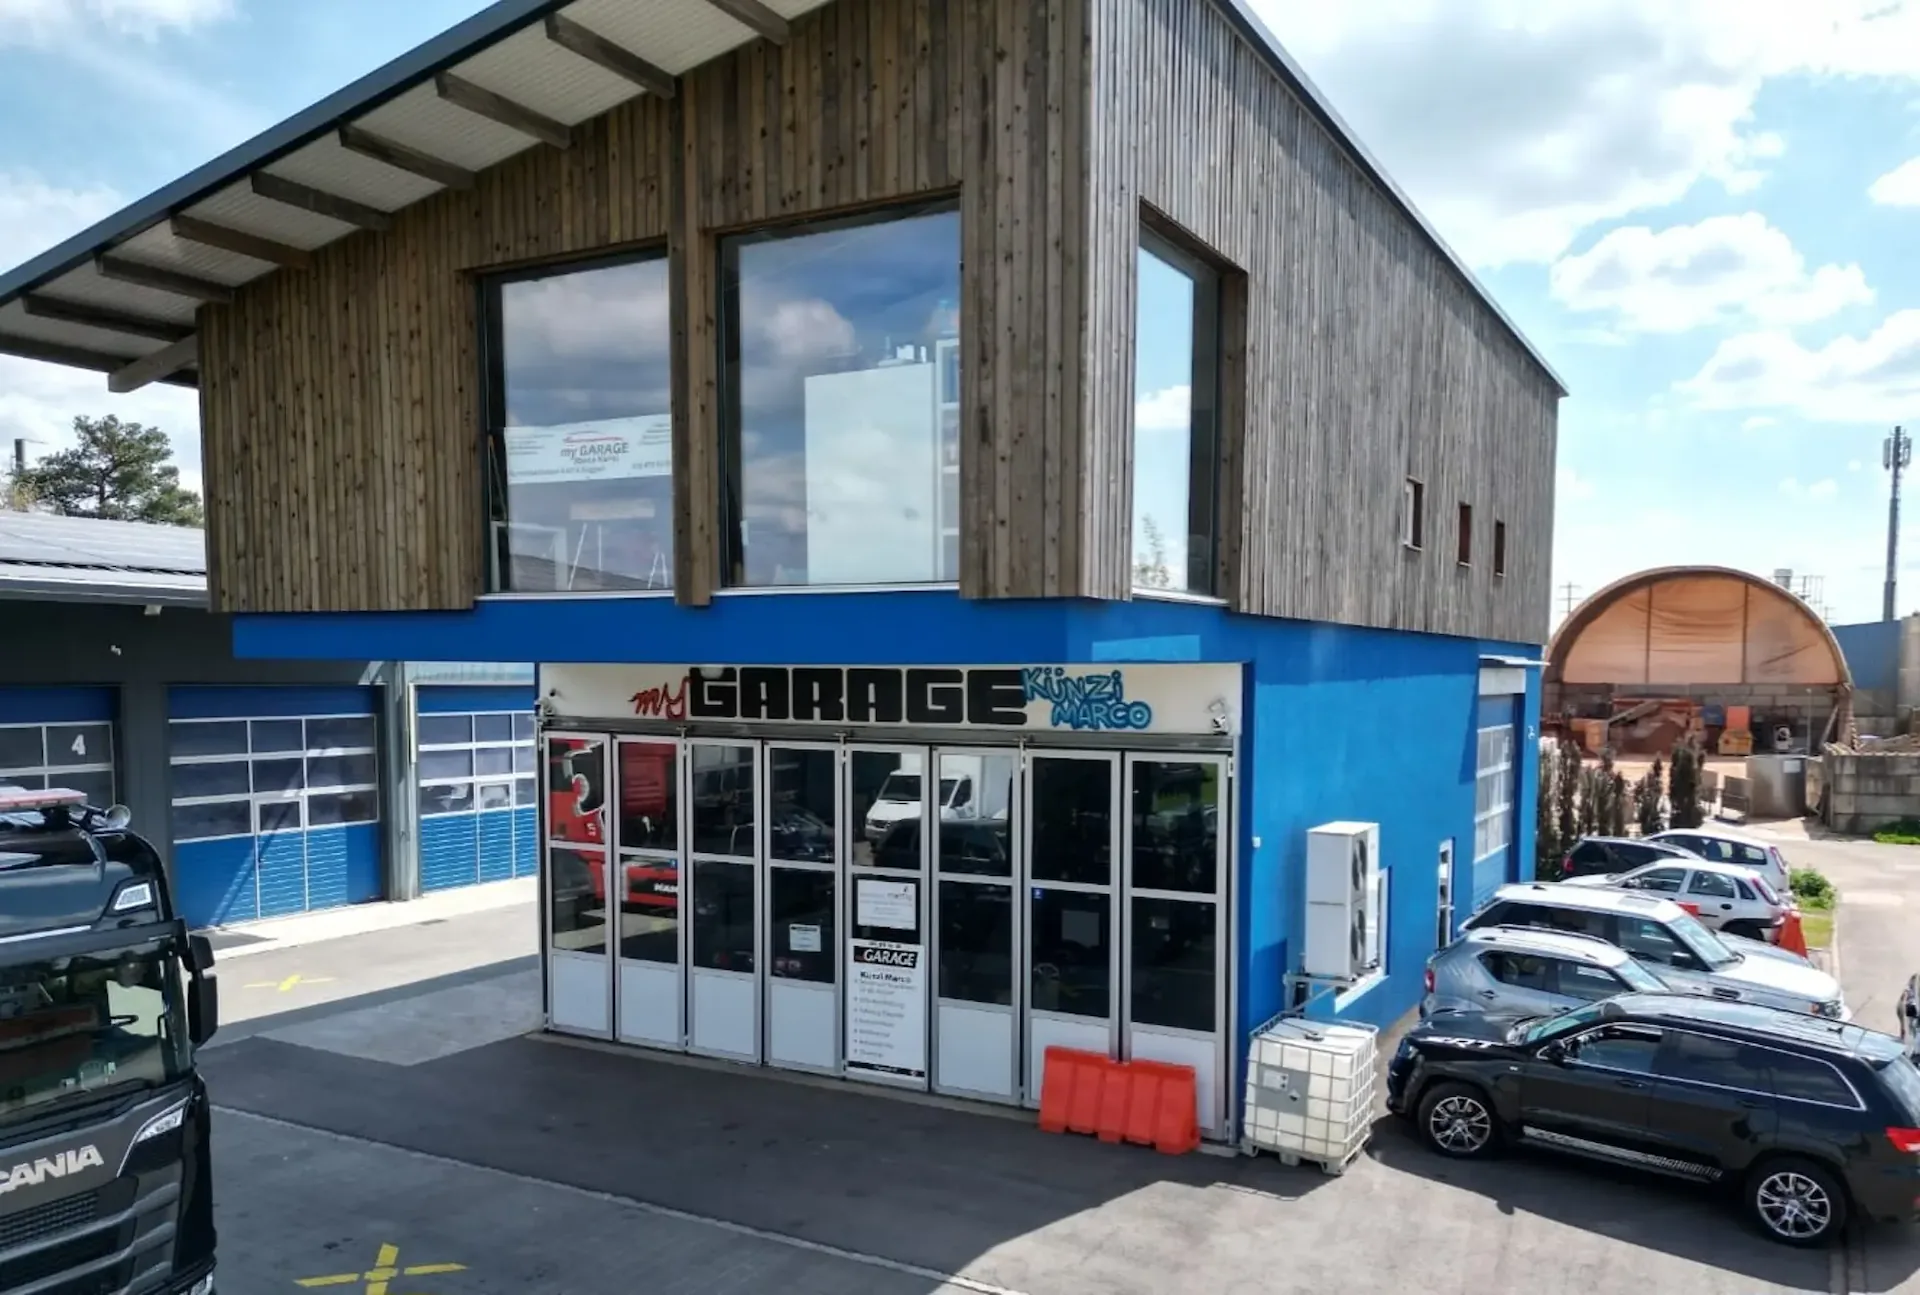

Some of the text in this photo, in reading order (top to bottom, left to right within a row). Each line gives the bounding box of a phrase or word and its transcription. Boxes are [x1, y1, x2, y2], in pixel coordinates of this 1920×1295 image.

[580, 442, 629, 456] GARAGE
[629, 675, 691, 720] my
[689, 667, 1027, 725] GARAGE
[1051, 700, 1153, 730] MARCO
[71, 733, 86, 756] 4
[863, 948, 916, 972] GARAGE
